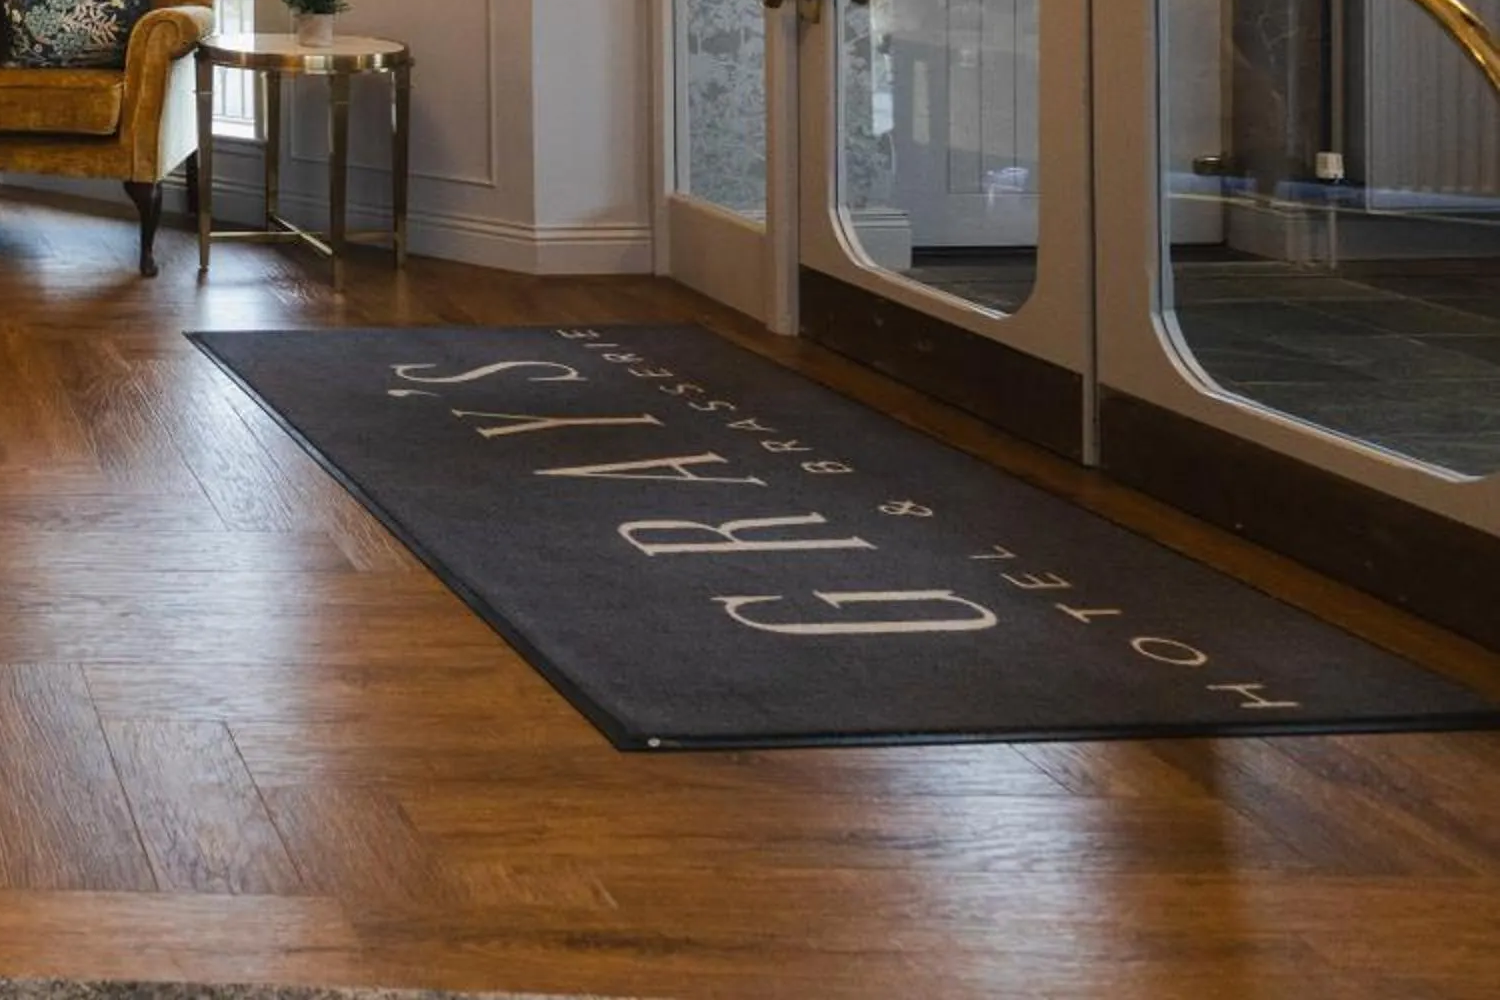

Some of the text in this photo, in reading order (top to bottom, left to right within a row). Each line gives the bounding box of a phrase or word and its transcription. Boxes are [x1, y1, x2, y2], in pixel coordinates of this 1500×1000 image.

[386, 360, 998, 636] GRAY'S
[556, 328, 1300, 709] HOTEL & BRASSERIE
